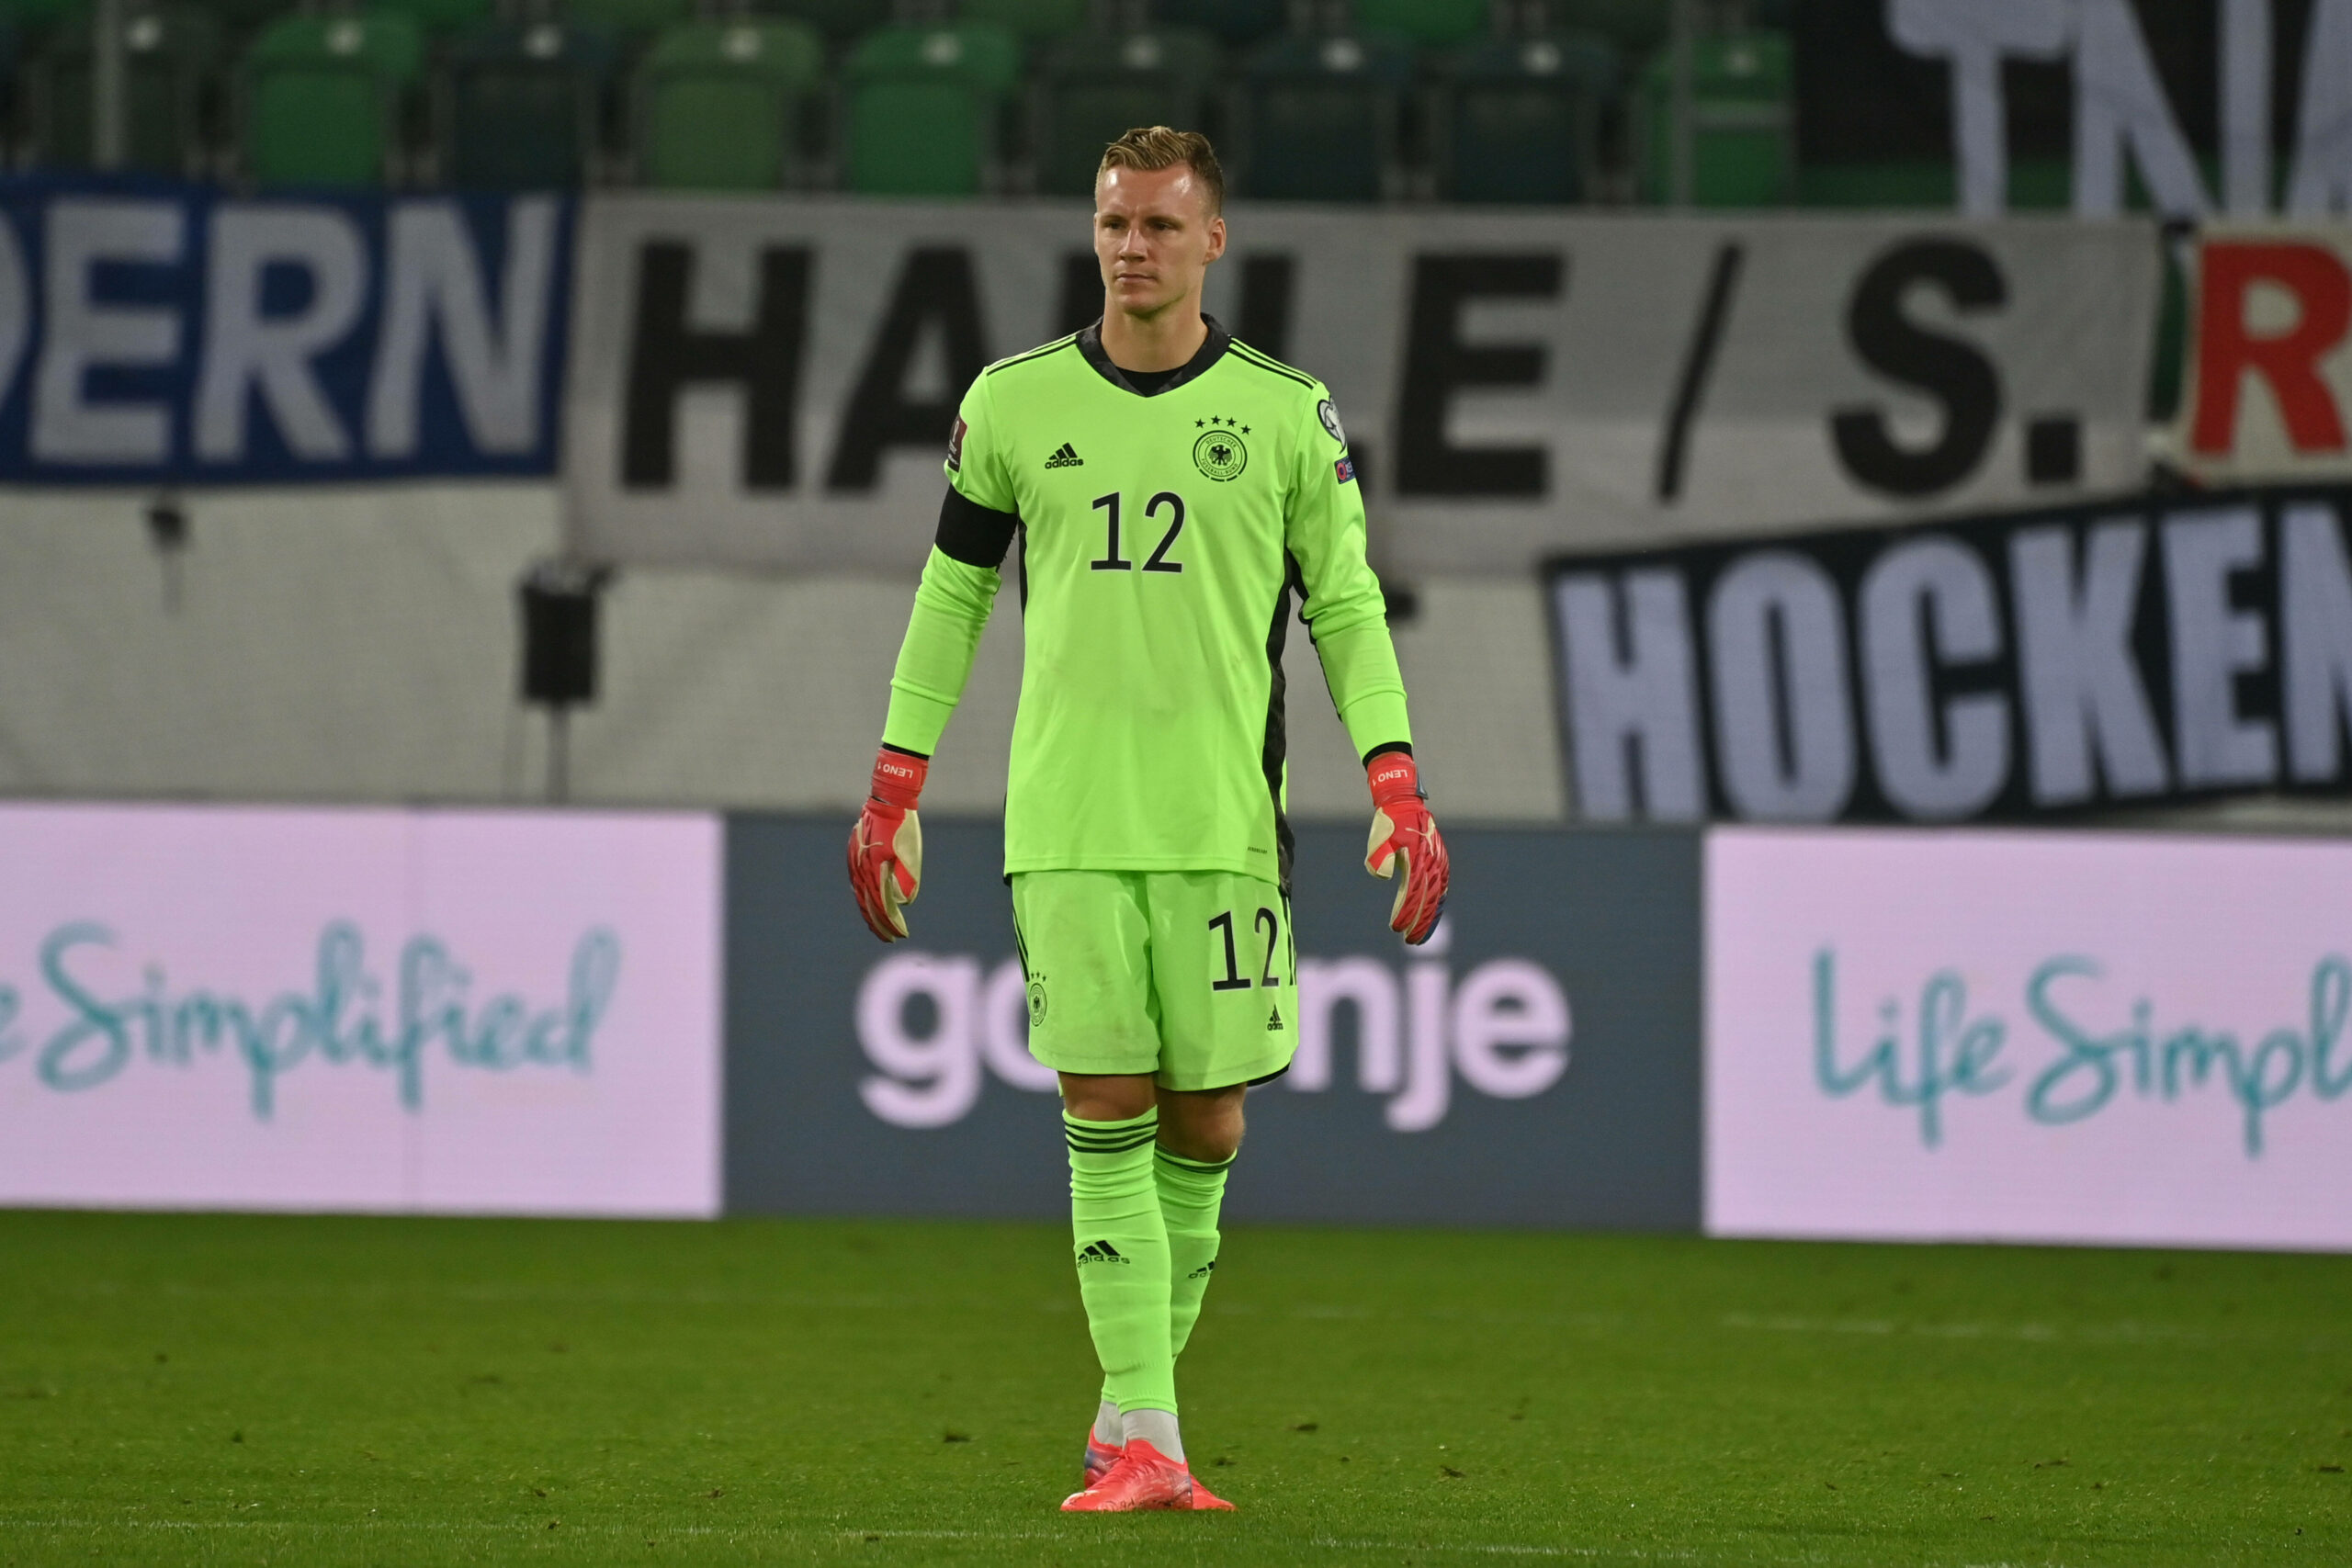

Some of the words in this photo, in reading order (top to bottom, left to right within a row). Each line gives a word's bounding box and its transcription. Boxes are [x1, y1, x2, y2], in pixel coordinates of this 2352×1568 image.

[0, 197, 560, 462] ERN
[618, 237, 1565, 502] HAE
[1655, 237, 1742, 502] /
[1828, 233, 2082, 502] S.
[1045, 458, 1084, 469] adidas
[1091, 491, 1185, 573] 12
[883, 763, 913, 779] LENO
[1378, 769, 1408, 783] LENO
[1208, 907, 1280, 991] 12
[37, 919, 623, 1124] Simplified
[854, 919, 1573, 1131] gonje
[1812, 944, 2018, 1154] Life
[2023, 952, 2352, 1161] Simpl
[1077, 1255, 1130, 1268] adidas
